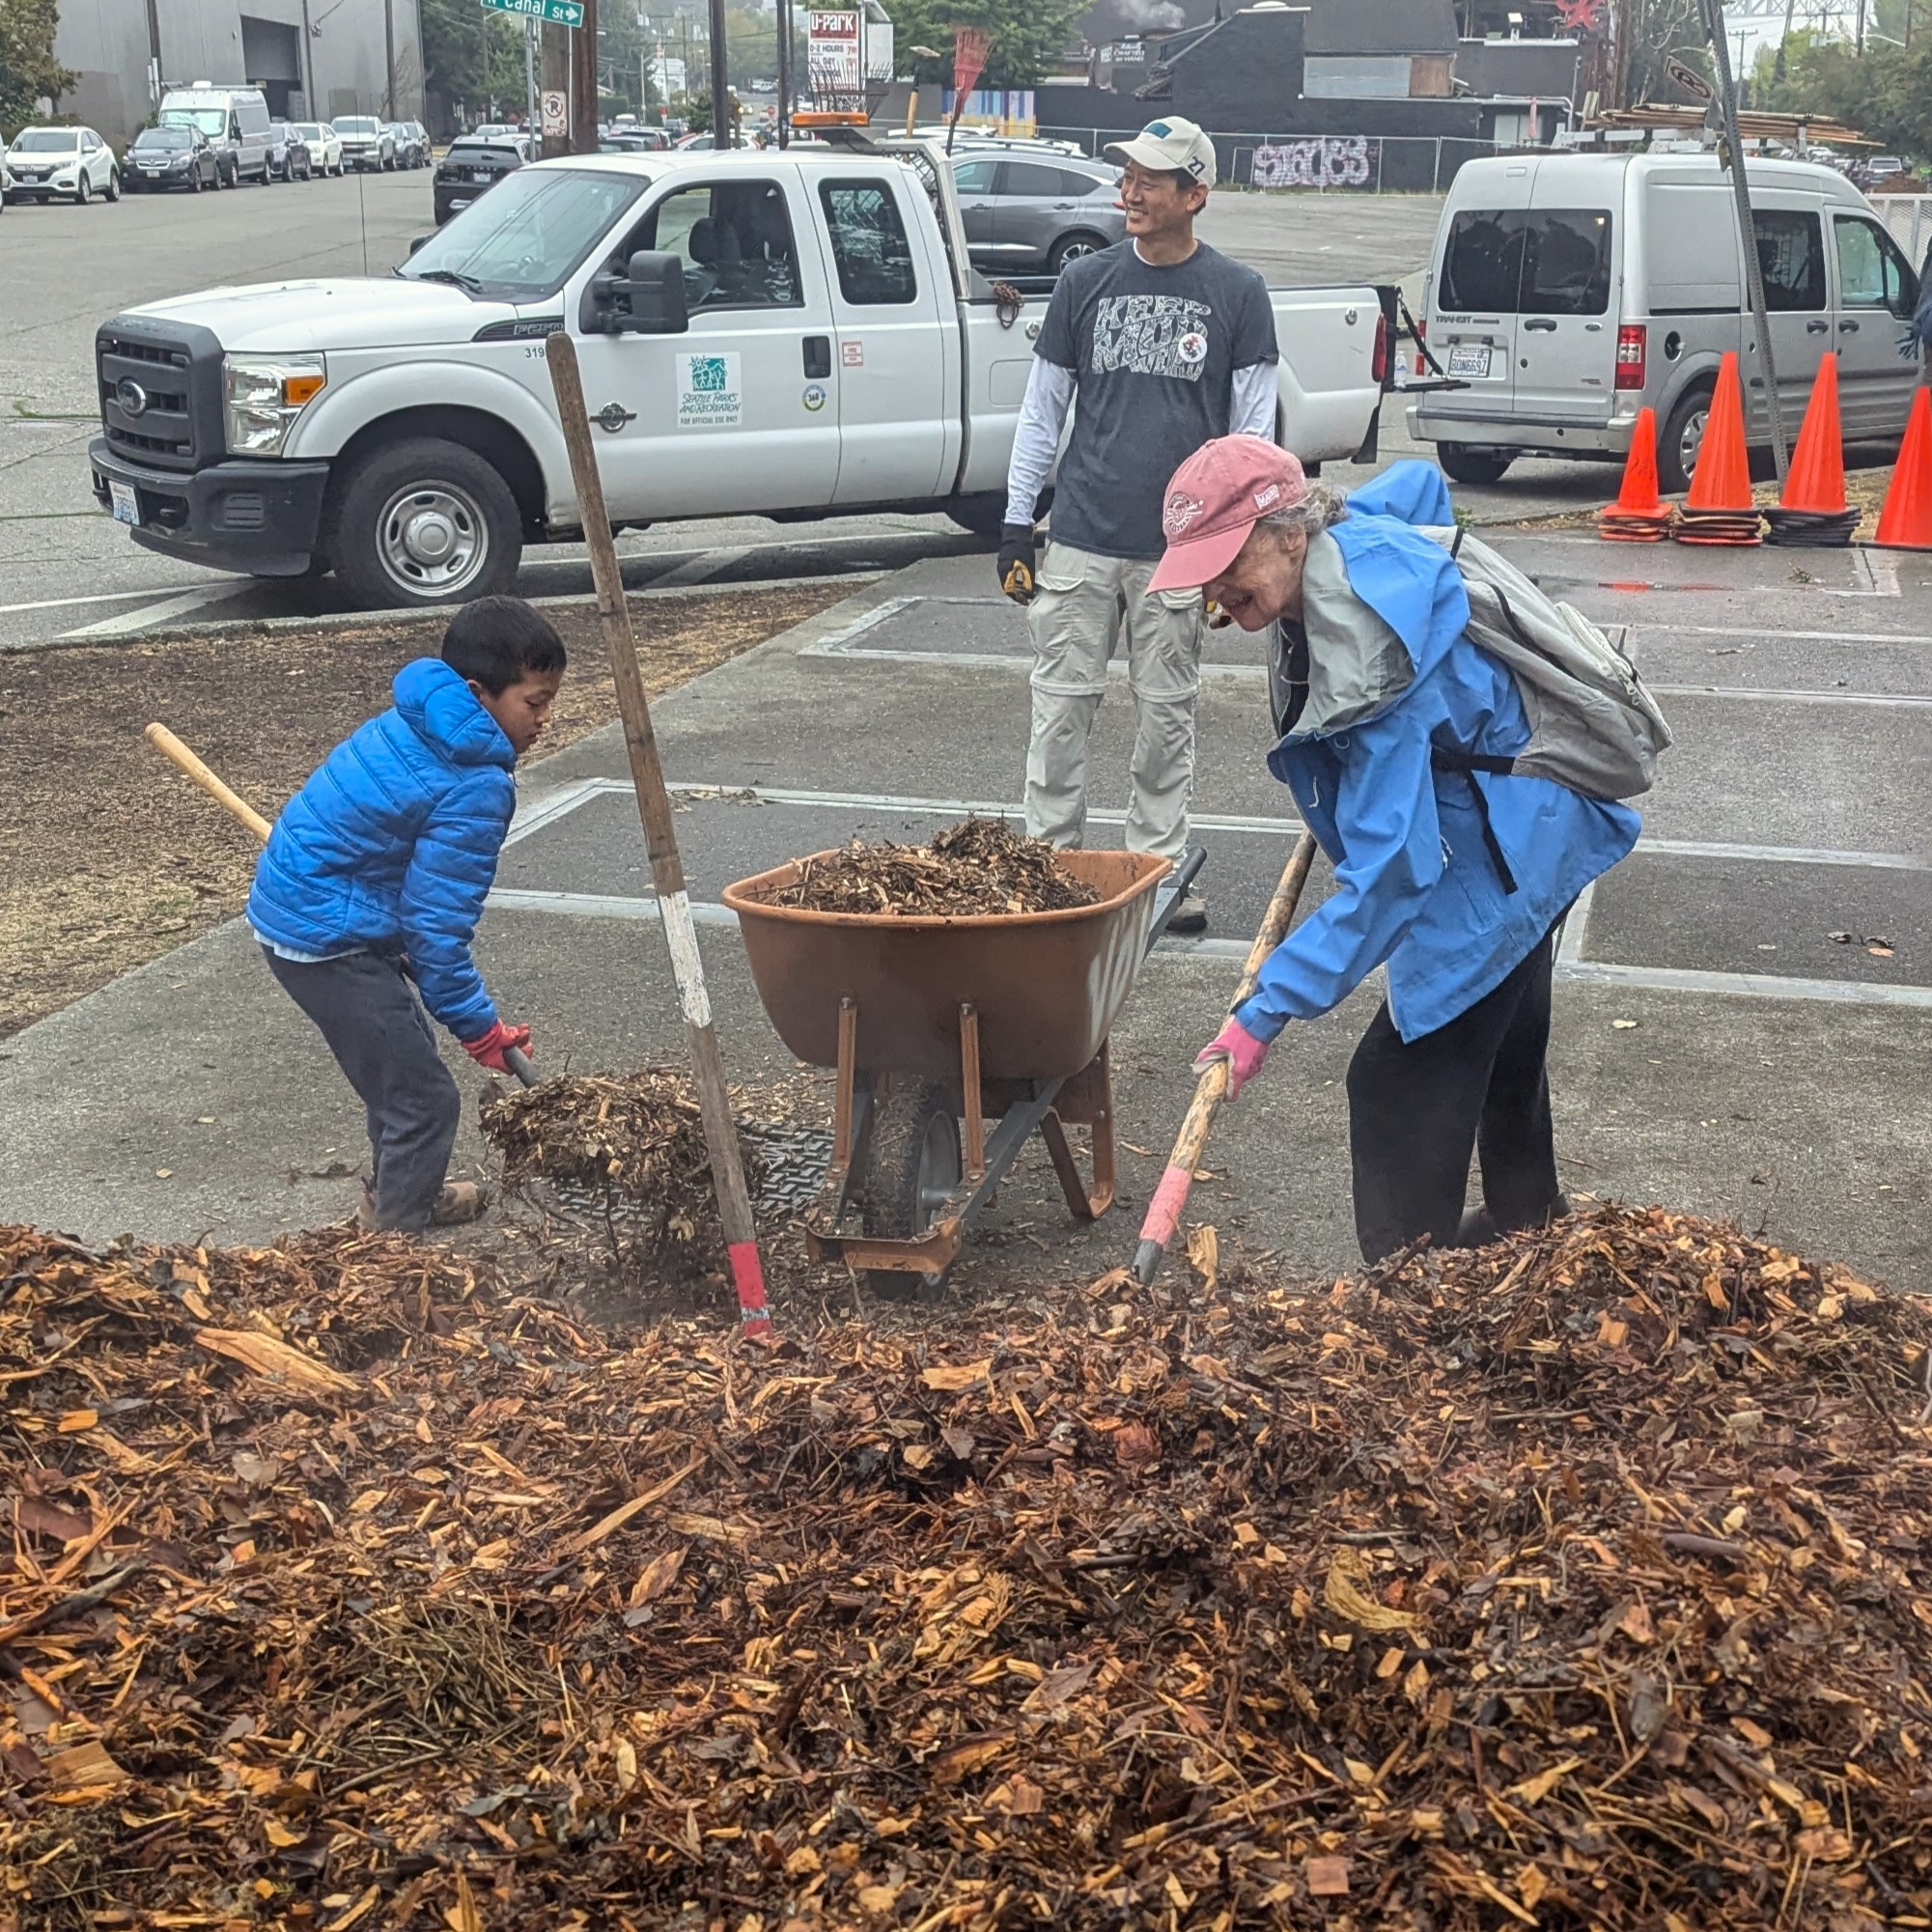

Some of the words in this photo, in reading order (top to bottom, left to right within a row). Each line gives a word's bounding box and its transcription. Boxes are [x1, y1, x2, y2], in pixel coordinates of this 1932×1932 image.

[505, 0, 546, 15] Canal
[552, 6, 564, 19] St
[823, 44, 844, 53] HOURS
[1188, 155, 1205, 176] 27
[524, 348, 545, 358] 319
[682, 393, 712, 405] SEATTLE
[713, 392, 738, 404] PARKS
[808, 392, 820, 402] 360
[680, 405, 696, 413] AND
[695, 403, 742, 413] RECREATION
[691, 416, 714, 425] OFFICIAL
